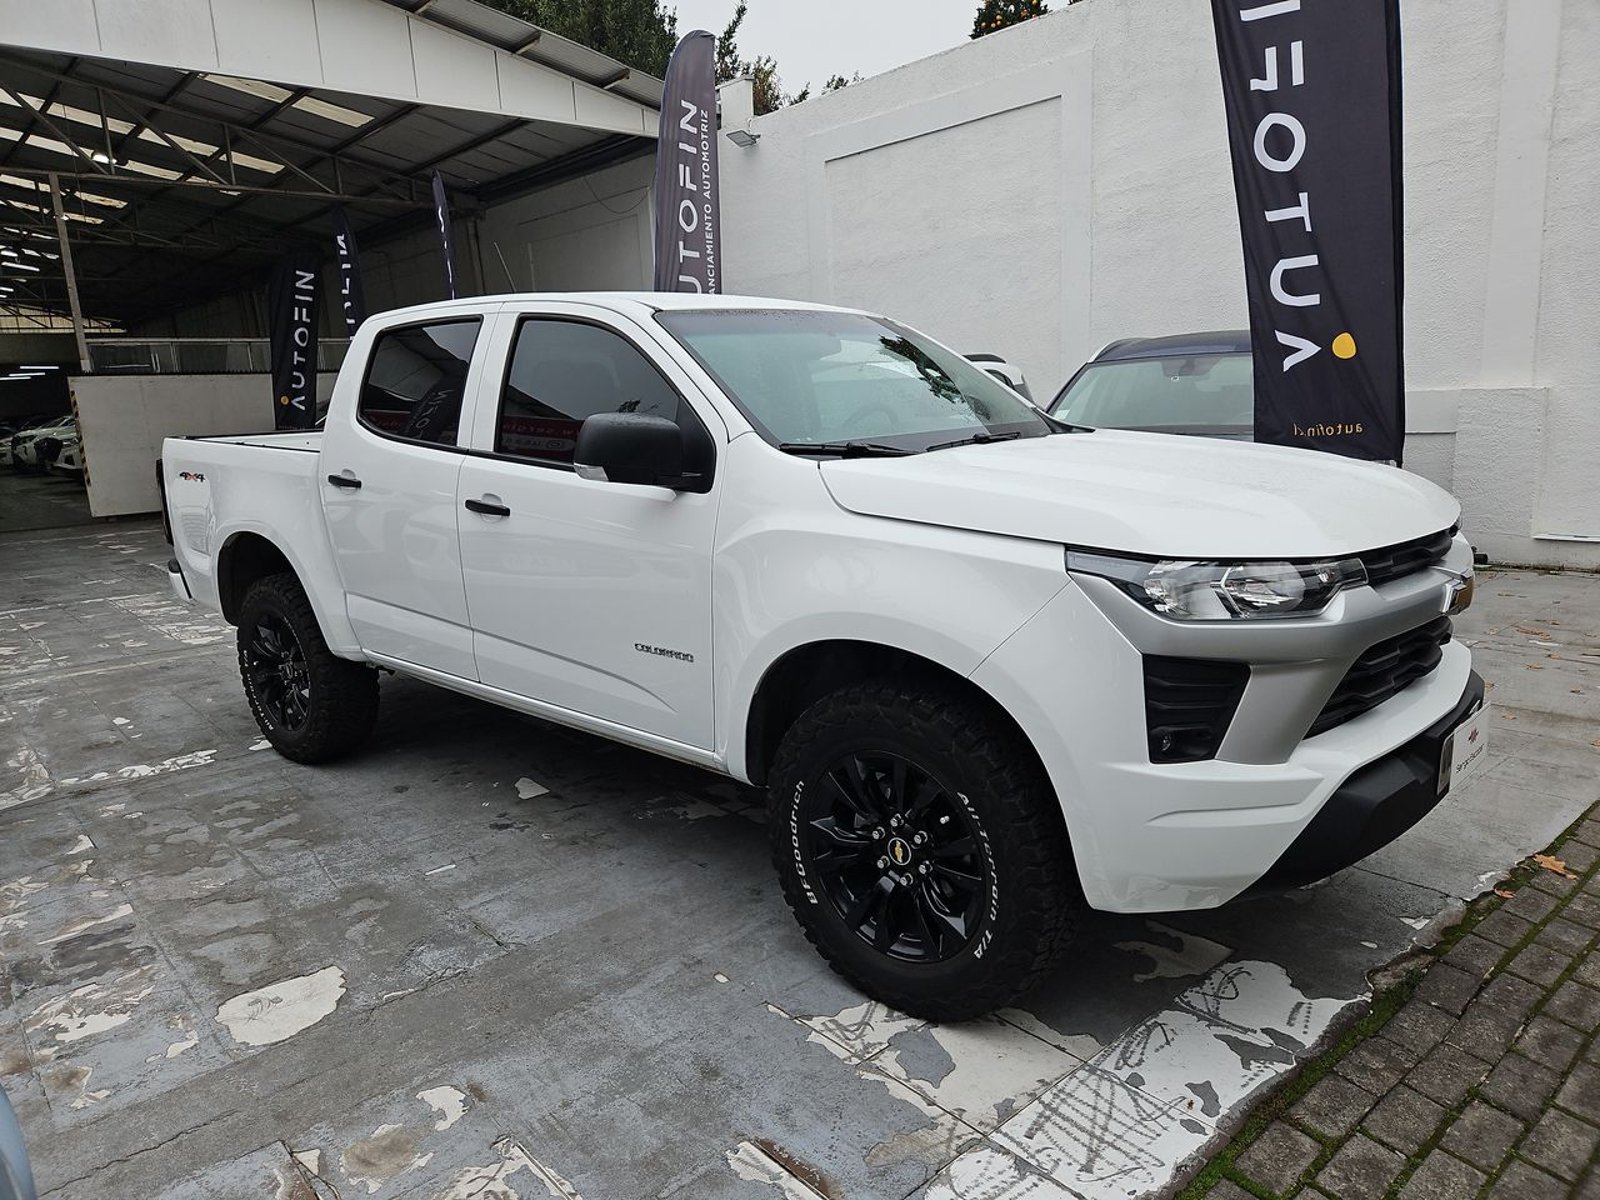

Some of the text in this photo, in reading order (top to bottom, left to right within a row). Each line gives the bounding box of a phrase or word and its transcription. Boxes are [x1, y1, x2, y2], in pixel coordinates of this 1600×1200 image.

[700, 109, 712, 200] AUTOMOTRIZ
[291, 269, 315, 411] AUTOFIN
[634, 643, 694, 662] COLORADO
